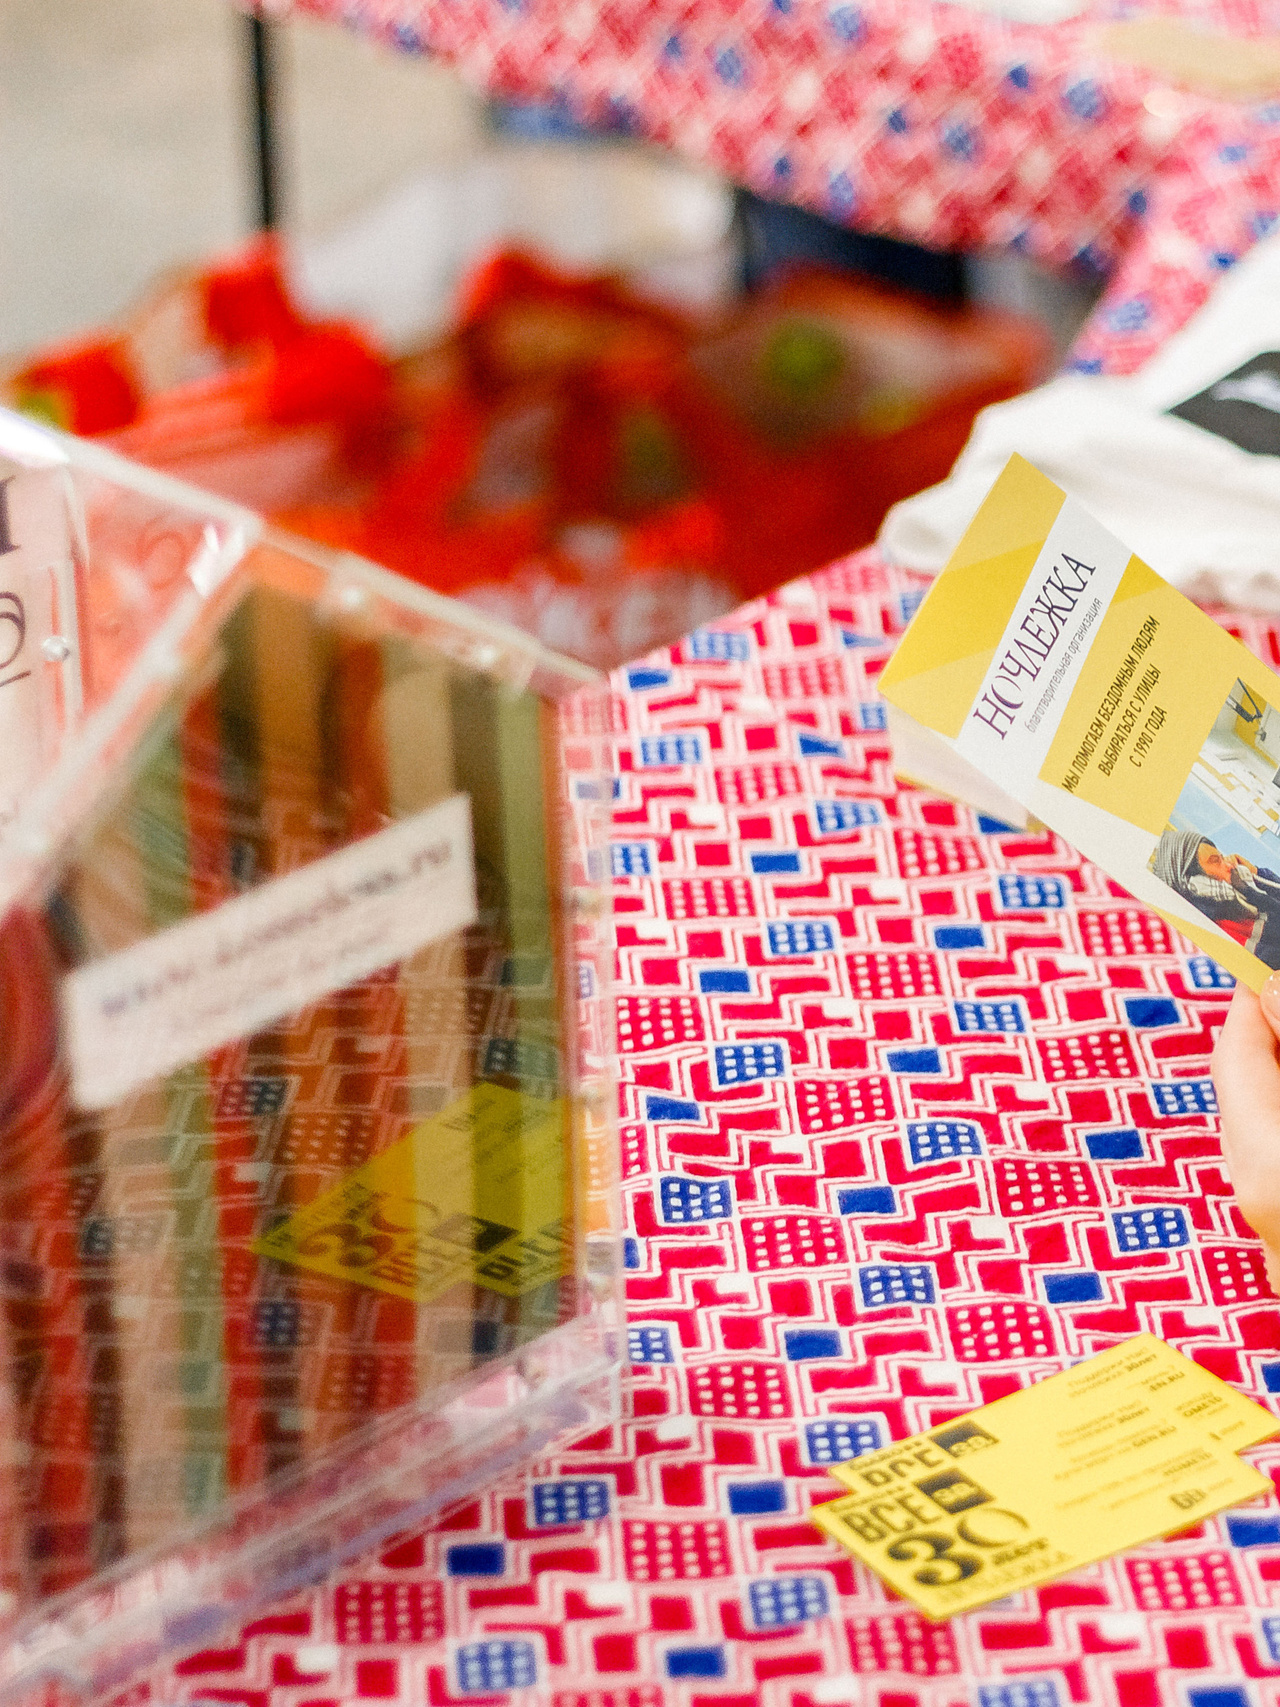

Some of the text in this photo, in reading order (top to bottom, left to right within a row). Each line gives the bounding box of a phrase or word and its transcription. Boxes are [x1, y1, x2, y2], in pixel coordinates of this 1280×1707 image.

[973, 552, 1097, 741] НОЧЛЕЖКА
[1024, 597, 1103, 733] благотворительная организация
[1061, 614, 1161, 794] МЫ ПОМОГАЕМ БЕЗДОМНЫМ ЛЮДЯМ
[1097, 662, 1162, 777] ВЫБИРАТЬСЯ С УЛИЦЫ
[1129, 705, 1168, 768] С 1990 ГОДА
[842, 1492, 943, 1545] ВСЕ
[886, 1507, 1030, 1588] 30
